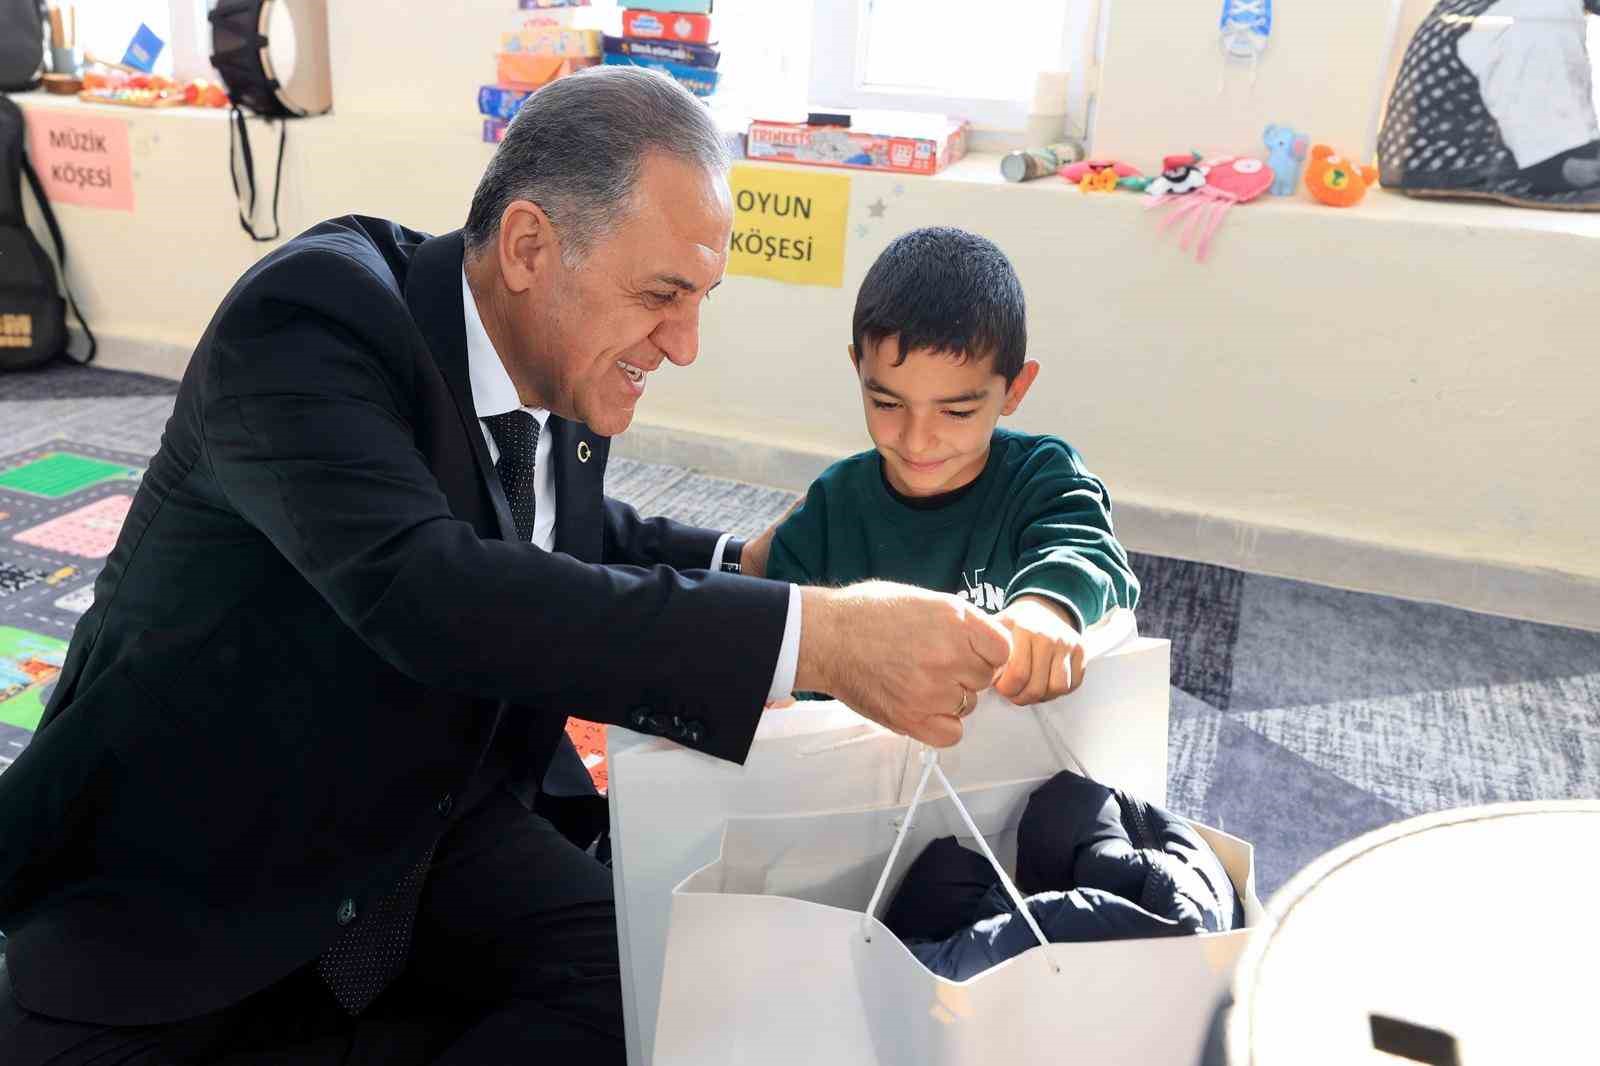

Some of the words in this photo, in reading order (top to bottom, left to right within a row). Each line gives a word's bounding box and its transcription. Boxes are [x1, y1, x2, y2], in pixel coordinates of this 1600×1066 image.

[49, 128, 107, 153] MÜZİK
[51, 162, 112, 190] KÖŞESİ
[736, 189, 812, 219] OYUN
[729, 228, 812, 262] KÖŞESİ
